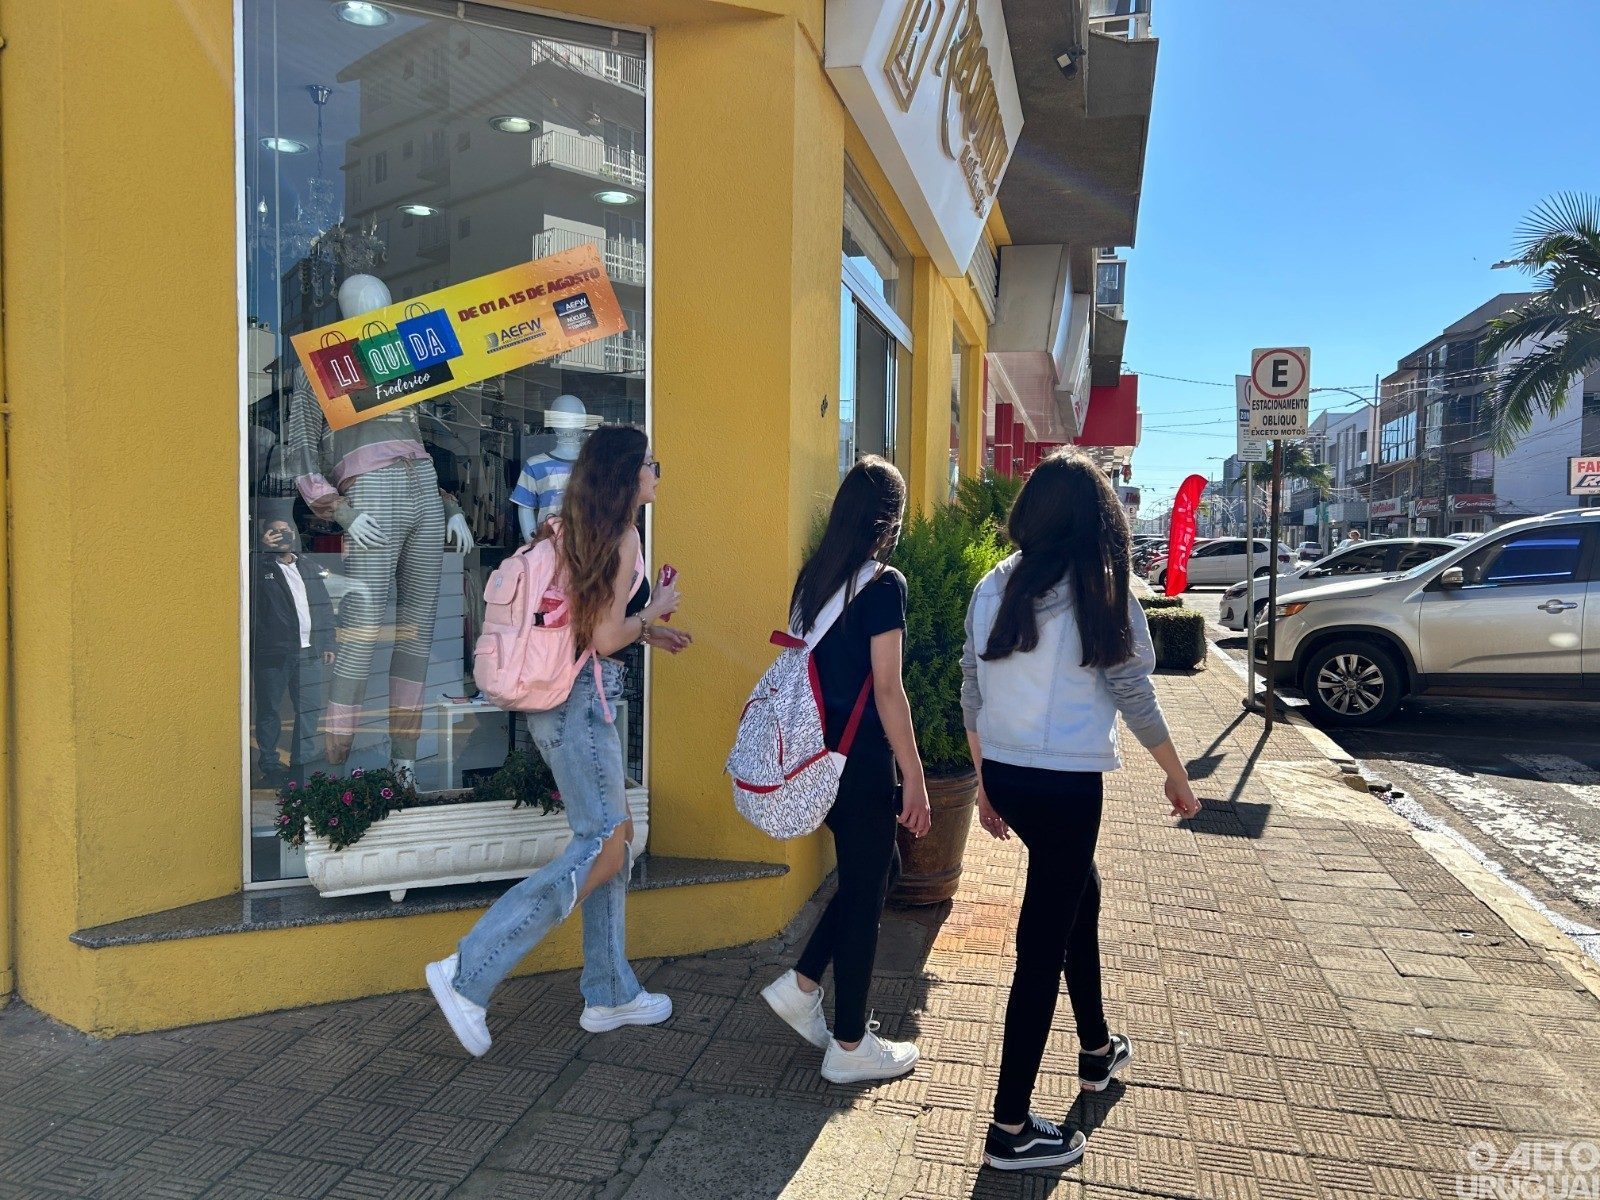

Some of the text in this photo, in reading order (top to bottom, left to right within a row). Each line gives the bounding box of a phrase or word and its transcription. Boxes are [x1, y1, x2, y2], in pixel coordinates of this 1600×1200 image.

[458, 267, 600, 322] DE 01 A 15 DE AGOSTO
[566, 297, 587, 312] AEFW
[501, 318, 541, 341] AEFW
[1272, 359, 1289, 388] E
[374, 371, 432, 400] Frederico
[1251, 399, 1308, 411] ESTACIONAMENTO
[1262, 413, 1297, 426] OBLÍQUO
